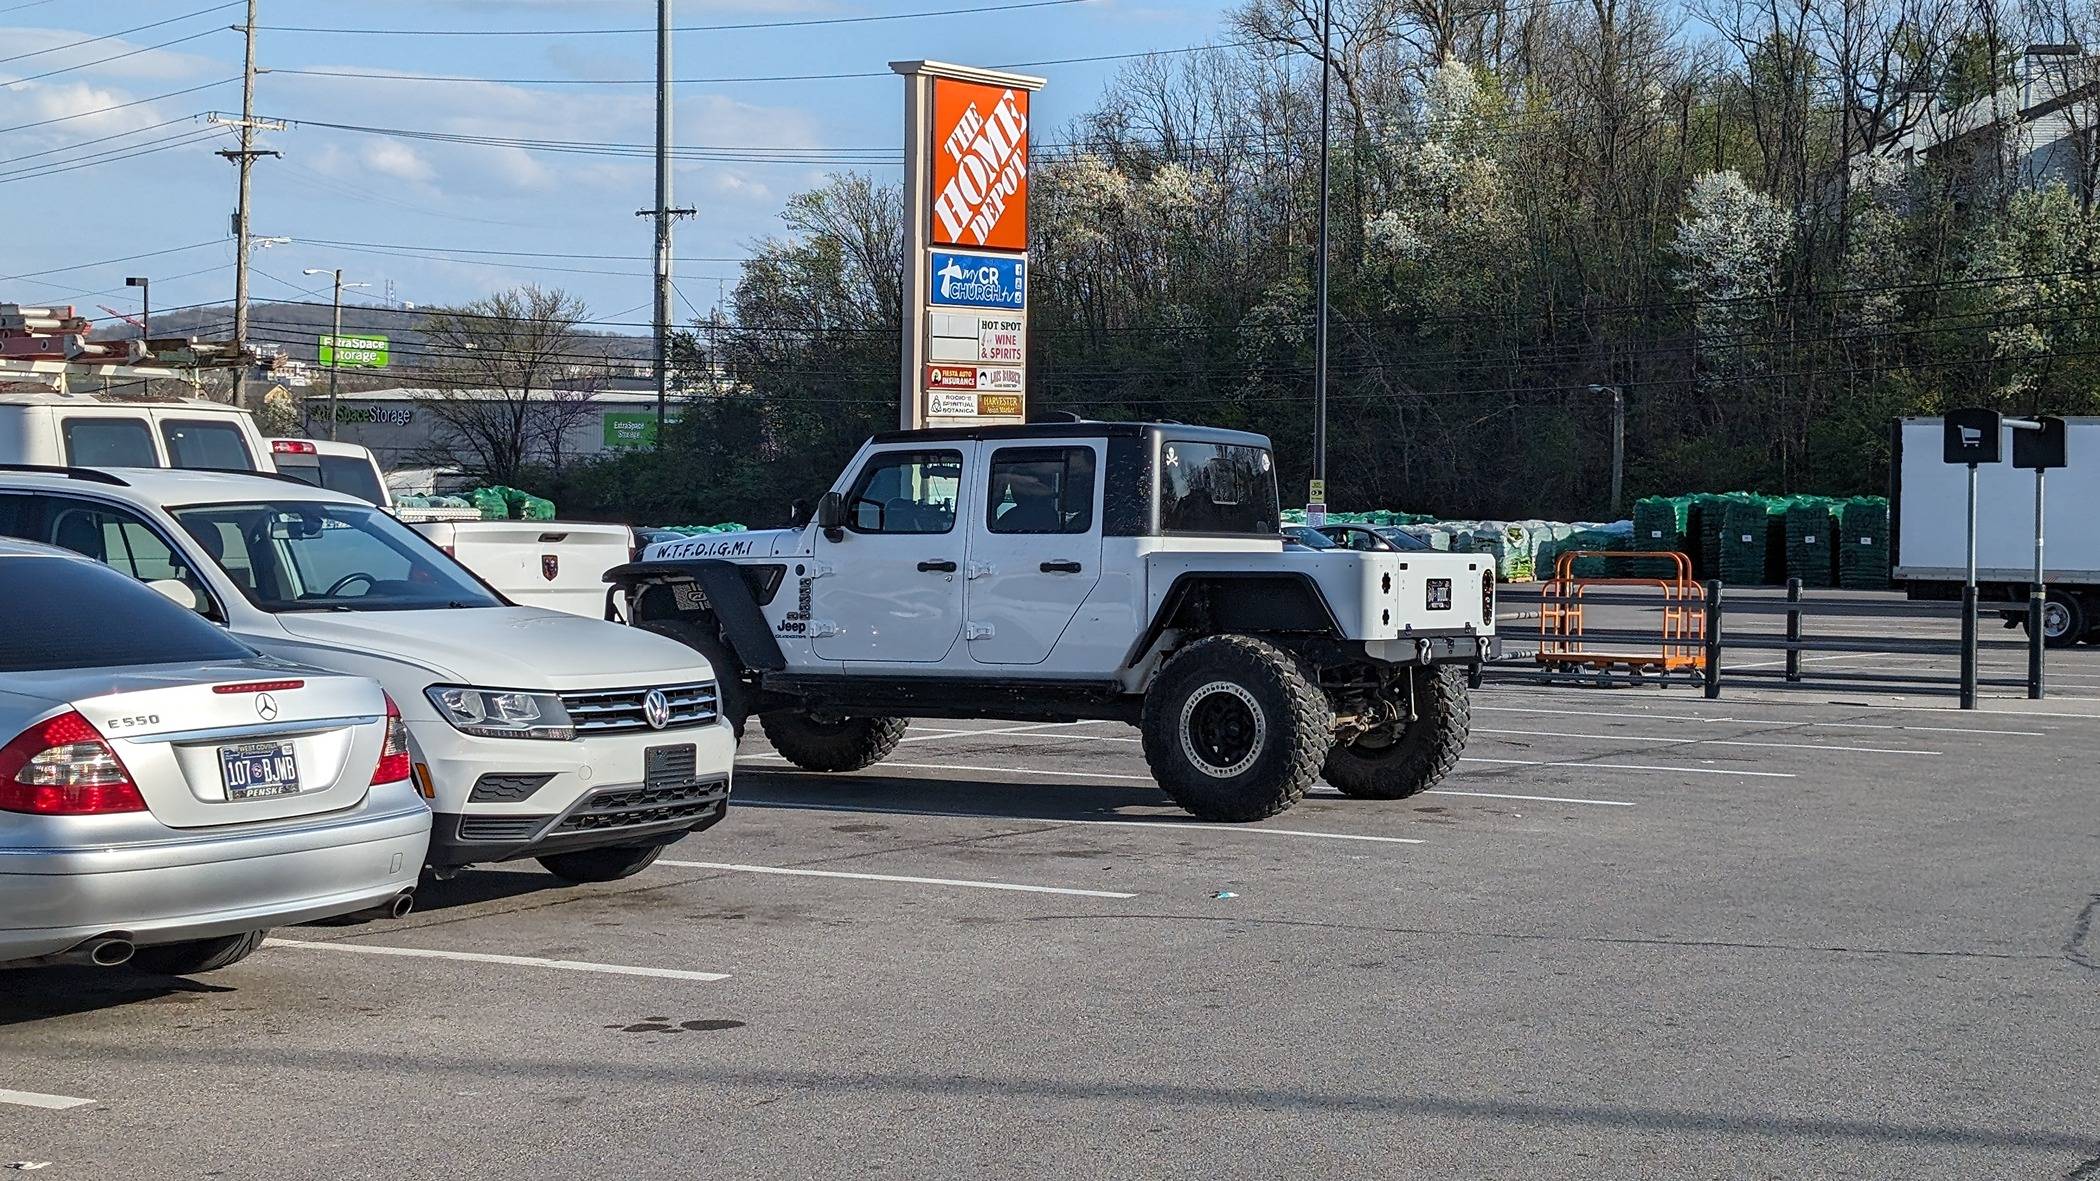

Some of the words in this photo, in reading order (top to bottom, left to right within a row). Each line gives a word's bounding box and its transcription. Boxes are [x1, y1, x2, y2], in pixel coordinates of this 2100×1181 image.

[944, 101, 984, 164] THE
[935, 89, 1027, 243] HOME
[970, 148, 1027, 246] DEPOT
[981, 320, 999, 330] HOT
[1000, 321, 1021, 331] SPOT
[324, 337, 385, 349] EtraSpace
[995, 334, 1017, 345] WINE
[981, 347, 988, 358] &
[990, 347, 1021, 360] SPIRITS
[942, 377, 975, 385] INSURANCE
[983, 396, 1018, 406] HARVESTER
[776, 619, 806, 634] Jeep
[228, 760, 251, 786] 107
[246, 786, 283, 797] PENSKE
